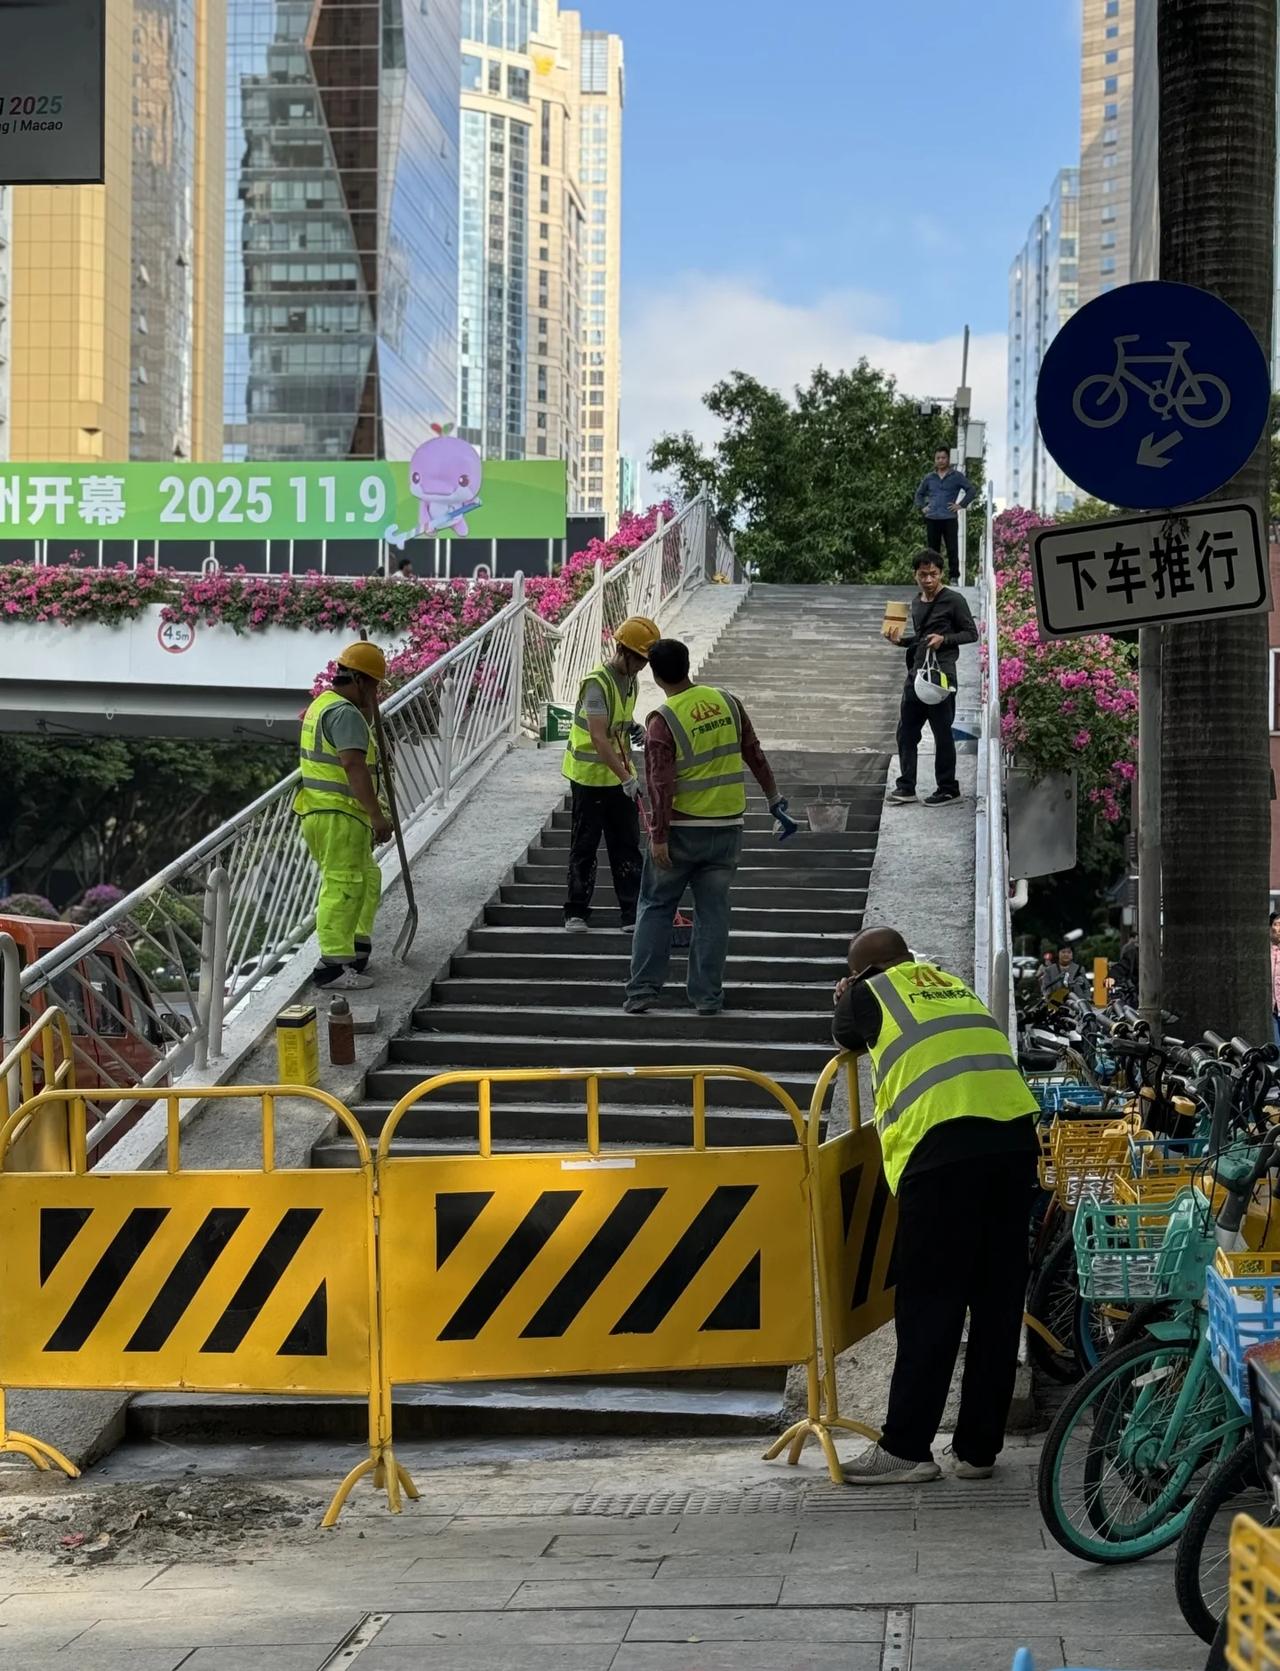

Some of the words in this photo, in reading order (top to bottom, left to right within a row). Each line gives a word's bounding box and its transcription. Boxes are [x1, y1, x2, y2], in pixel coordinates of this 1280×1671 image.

[9, 96, 63, 115] 2025
[20, 119, 63, 131] Macao
[159, 475, 273, 523] 2025
[289, 475, 386, 523] 11.9
[1056, 530, 1238, 611] 下车推行
